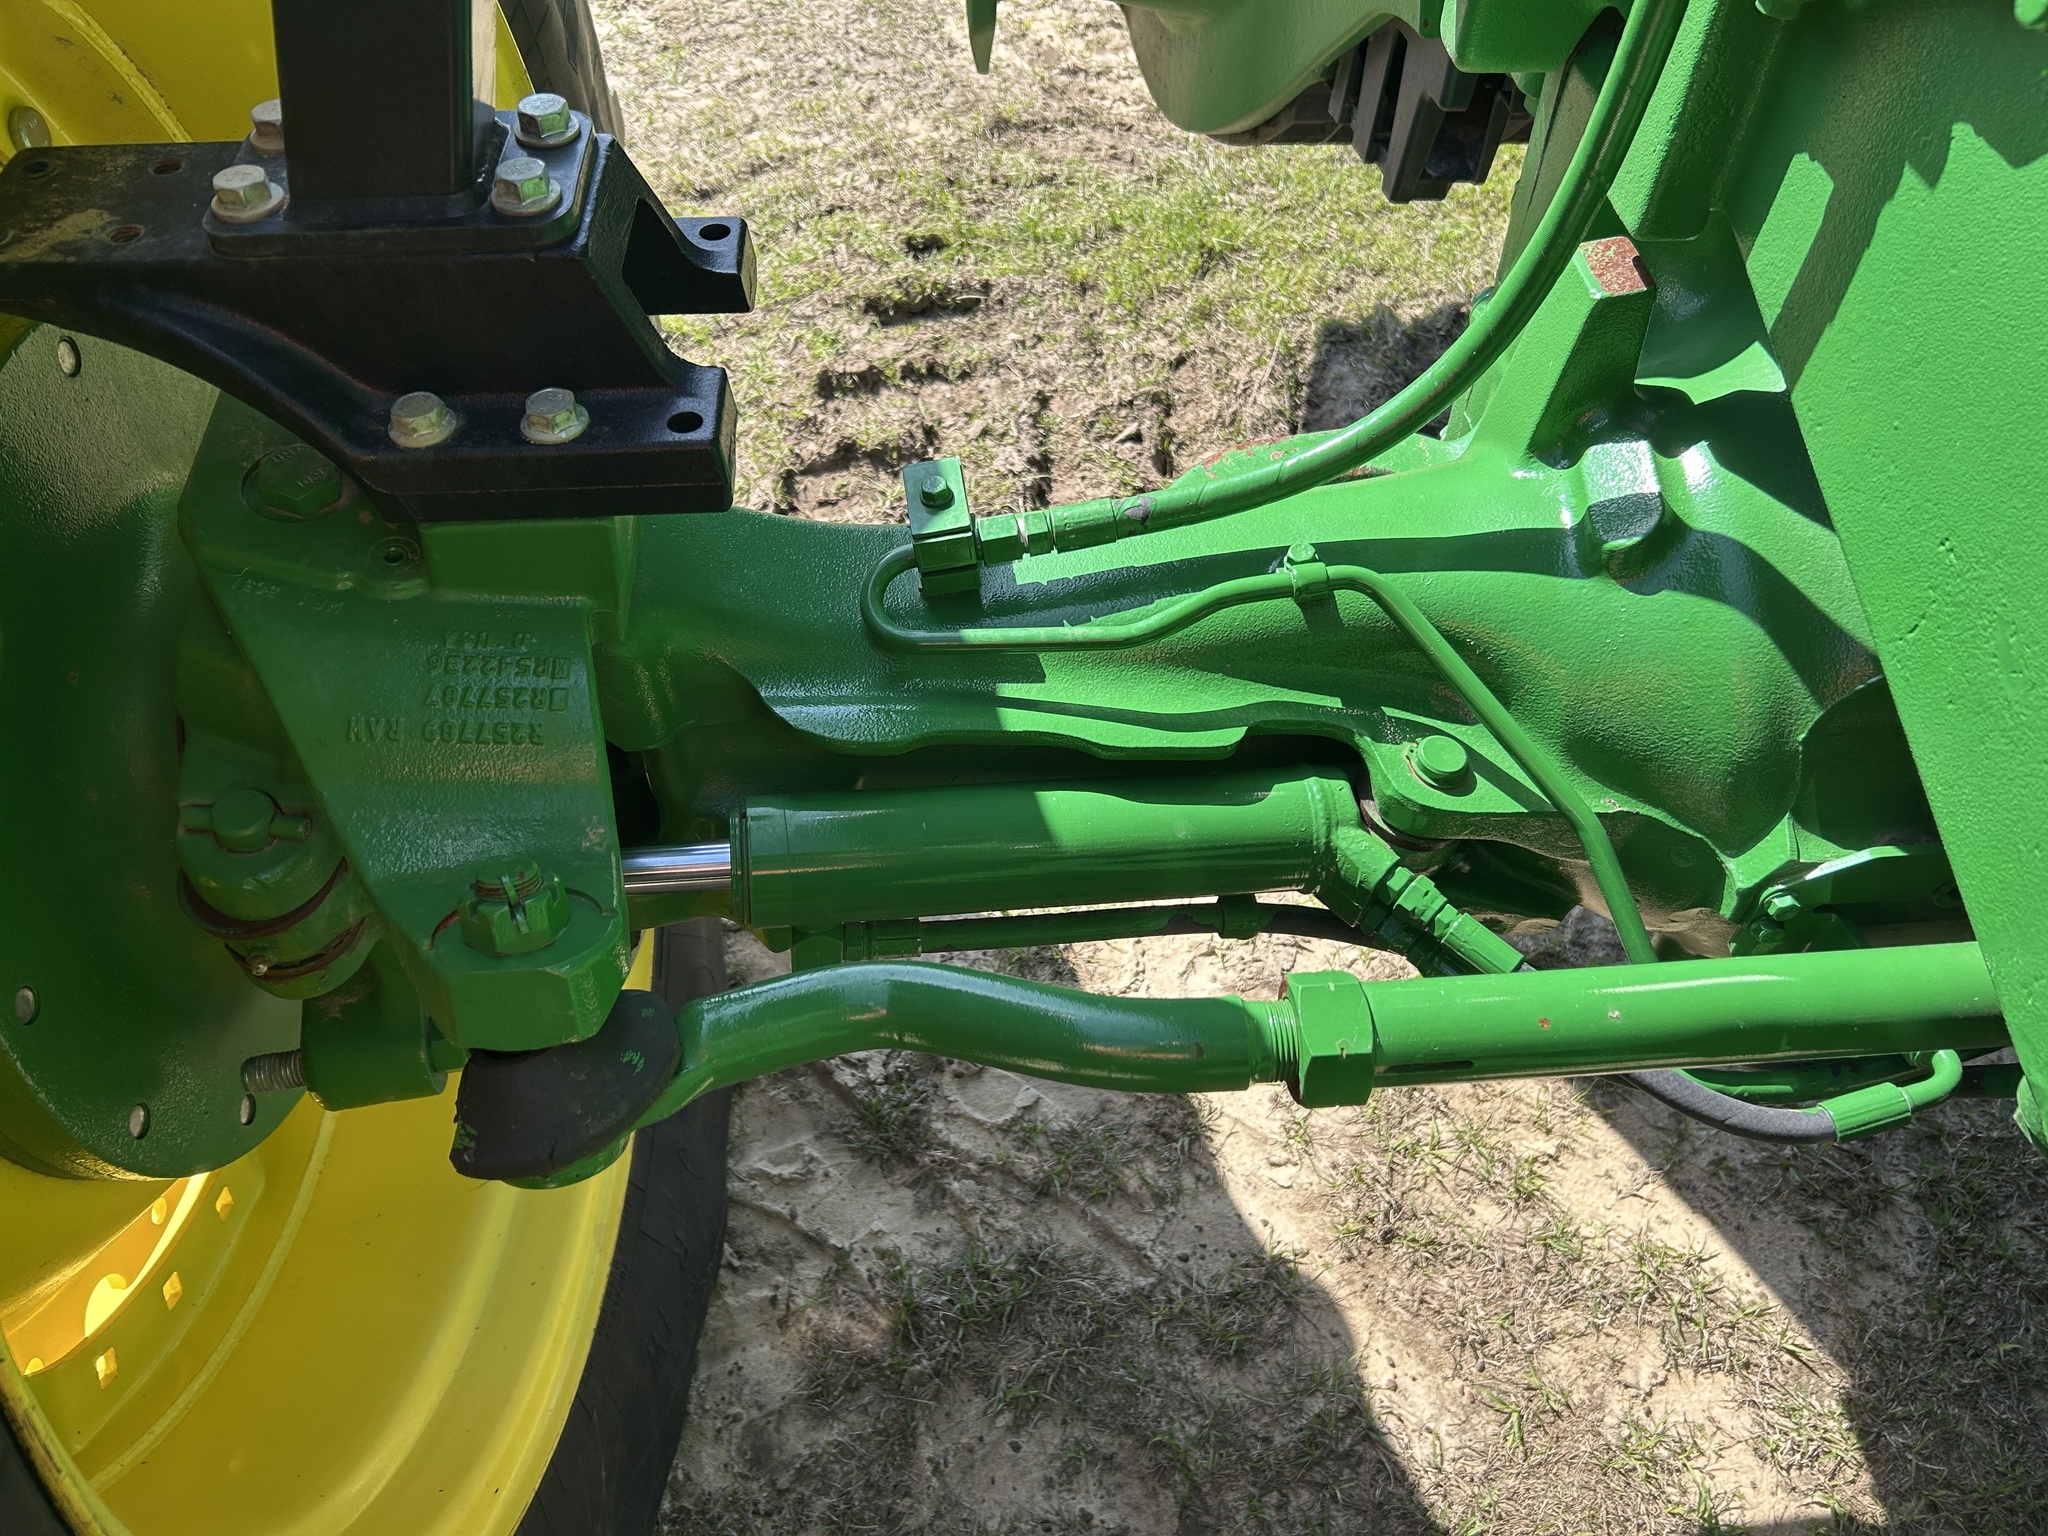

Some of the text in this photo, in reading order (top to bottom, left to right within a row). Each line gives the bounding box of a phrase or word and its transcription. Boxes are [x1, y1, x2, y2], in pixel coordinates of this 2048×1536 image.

[425, 684, 550, 712] R257787
[346, 715, 546, 747] R257789 RAW
